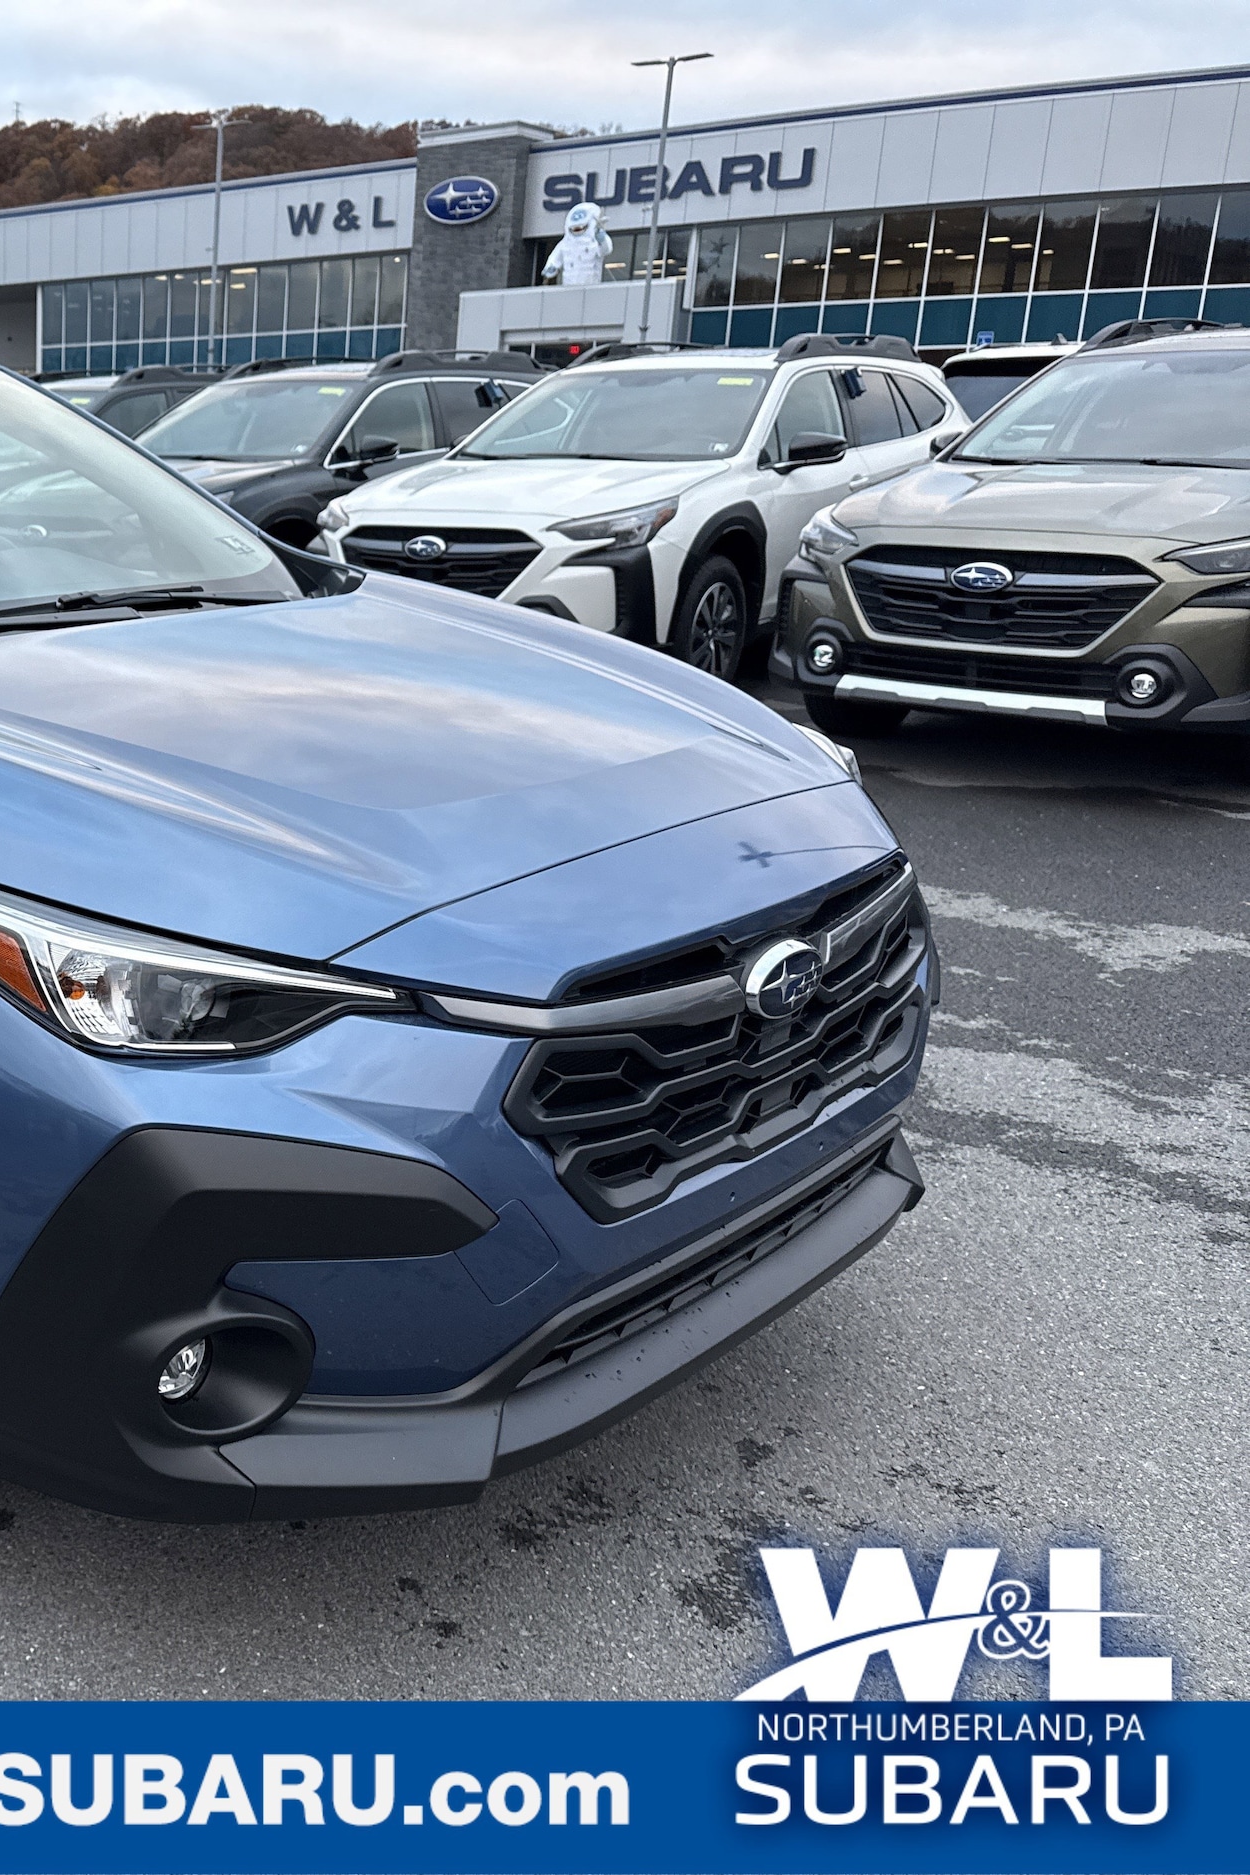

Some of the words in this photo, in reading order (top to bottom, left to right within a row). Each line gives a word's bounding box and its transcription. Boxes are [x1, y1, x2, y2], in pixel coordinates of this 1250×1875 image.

[542, 147, 817, 212] SUBARU
[287, 202, 326, 237] W
[333, 199, 361, 232] &
[372, 195, 396, 228] L
